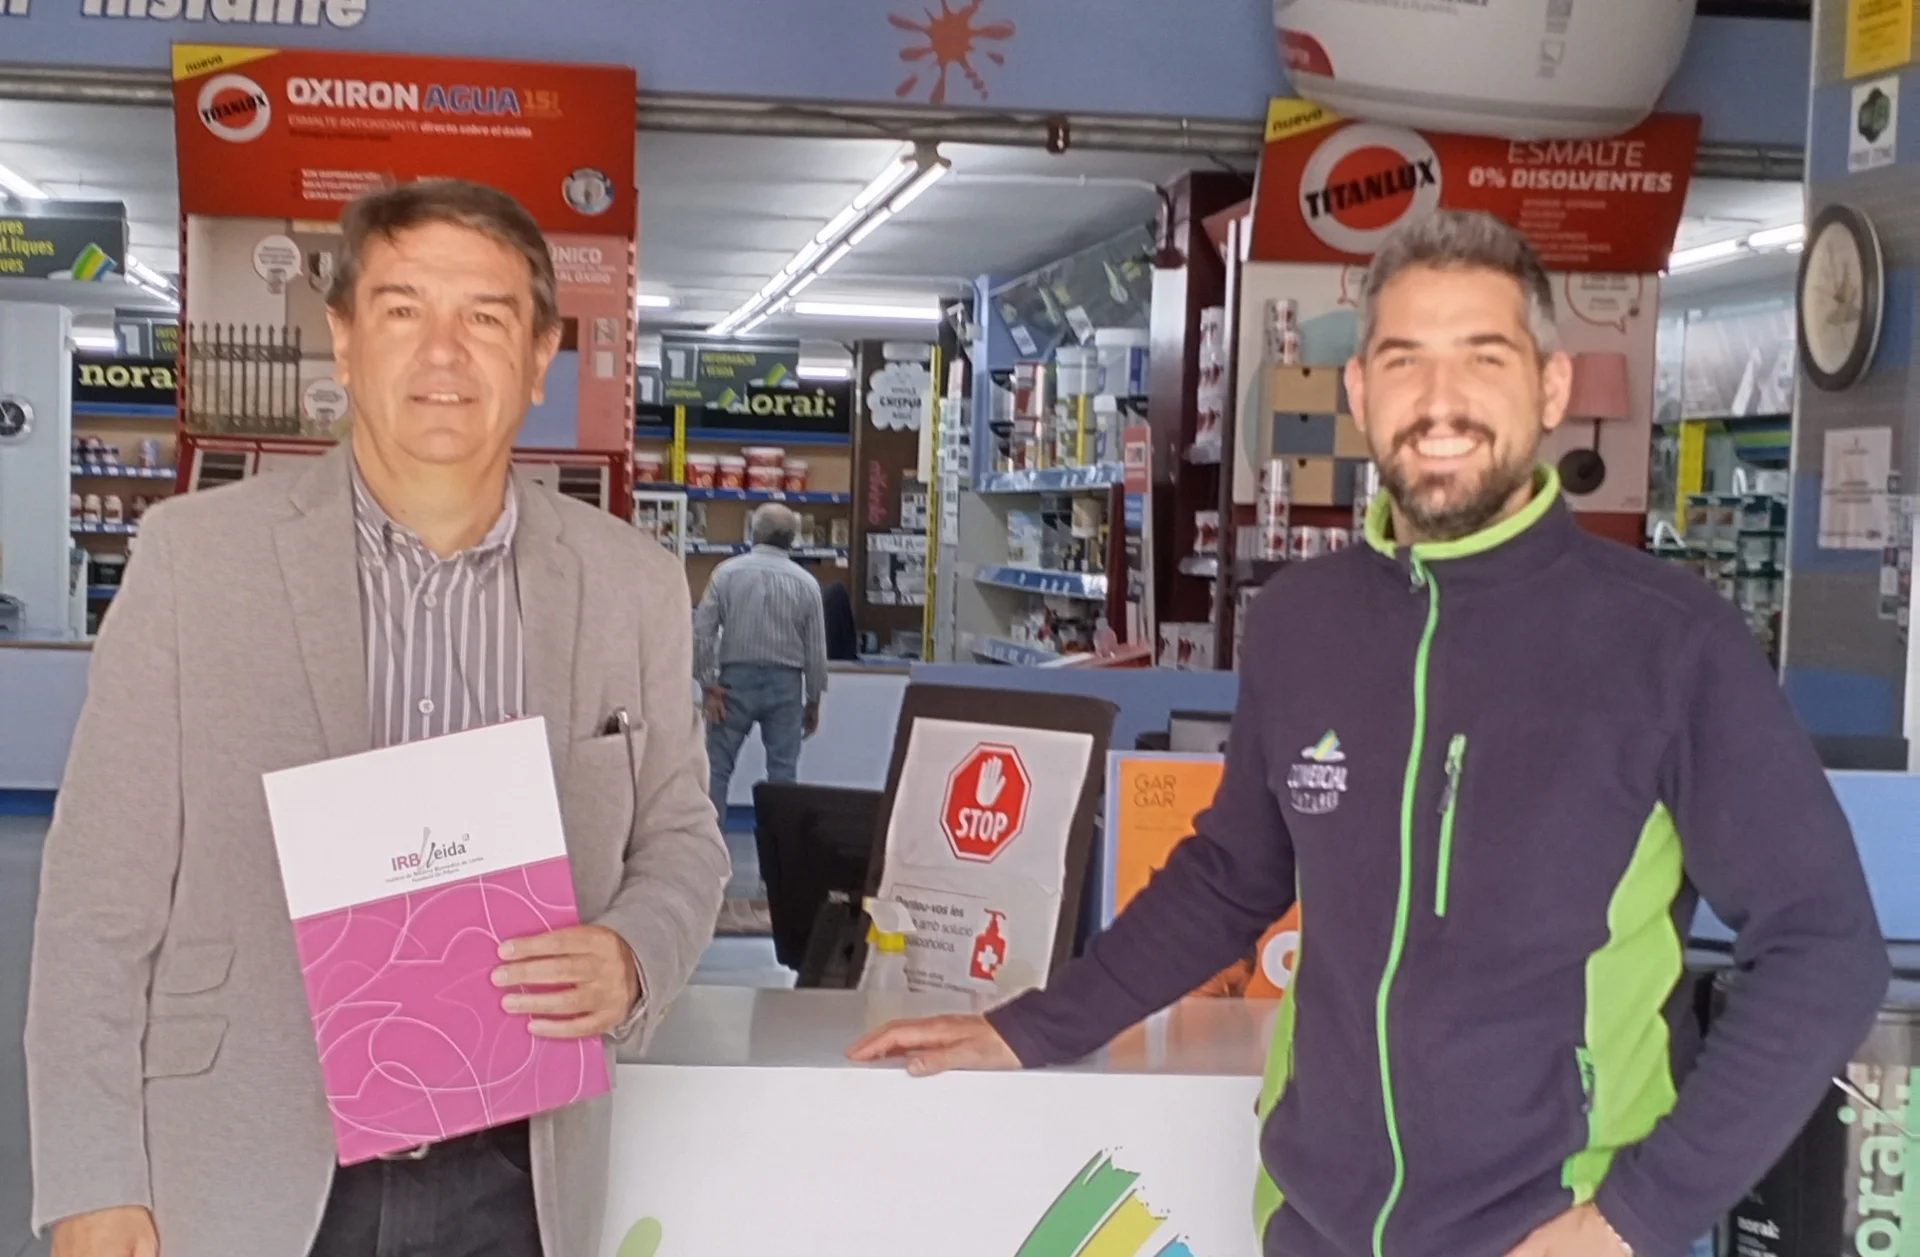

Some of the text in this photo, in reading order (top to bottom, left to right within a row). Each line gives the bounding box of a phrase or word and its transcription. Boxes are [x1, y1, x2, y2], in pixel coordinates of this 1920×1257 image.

[202, 93, 267, 124] TITANLUX
[286, 76, 419, 112] OXIRON
[423, 83, 522, 118] AGUA
[1272, 109, 1323, 131] nuevo
[1507, 139, 1646, 168] ESMALTE
[1305, 157, 1436, 219] TITANLUX
[1467, 166, 1673, 193] 0% DISOLVENTES
[78, 362, 178, 389] nora
[1134, 774, 1177, 791] GAR
[1133, 791, 1175, 808] GAR
[955, 807, 1009, 843] STOP
